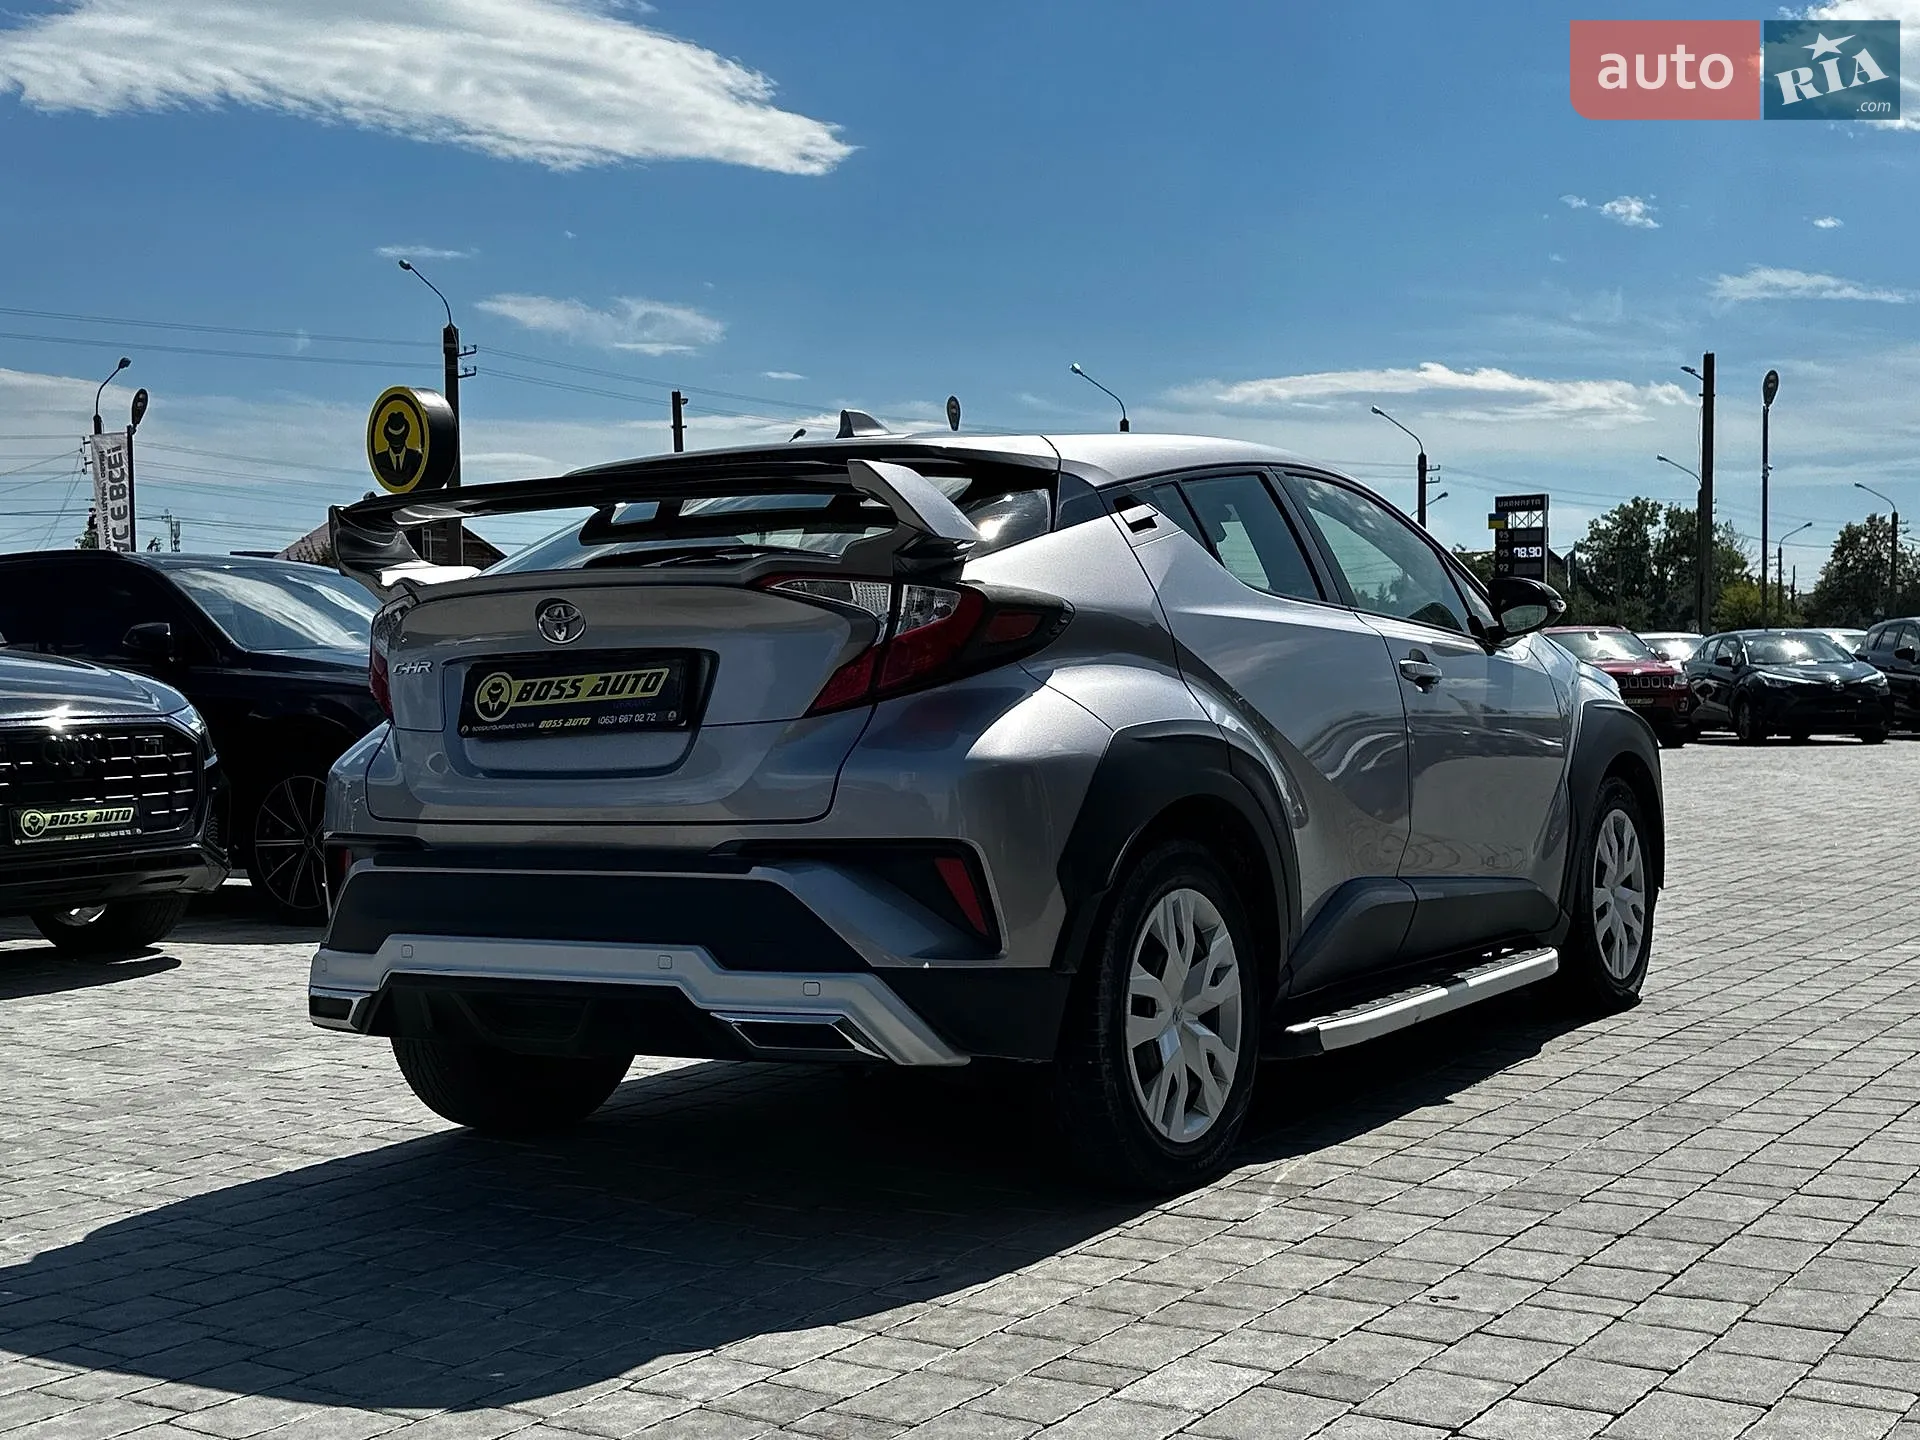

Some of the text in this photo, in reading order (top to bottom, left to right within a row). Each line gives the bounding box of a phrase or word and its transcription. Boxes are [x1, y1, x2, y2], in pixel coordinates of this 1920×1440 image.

[1498, 549, 1509, 557] 95
[516, 671, 664, 702] BOSS AUTO
[538, 719, 563, 728] BOSS
[48, 809, 132, 826] BOSS AUTO
